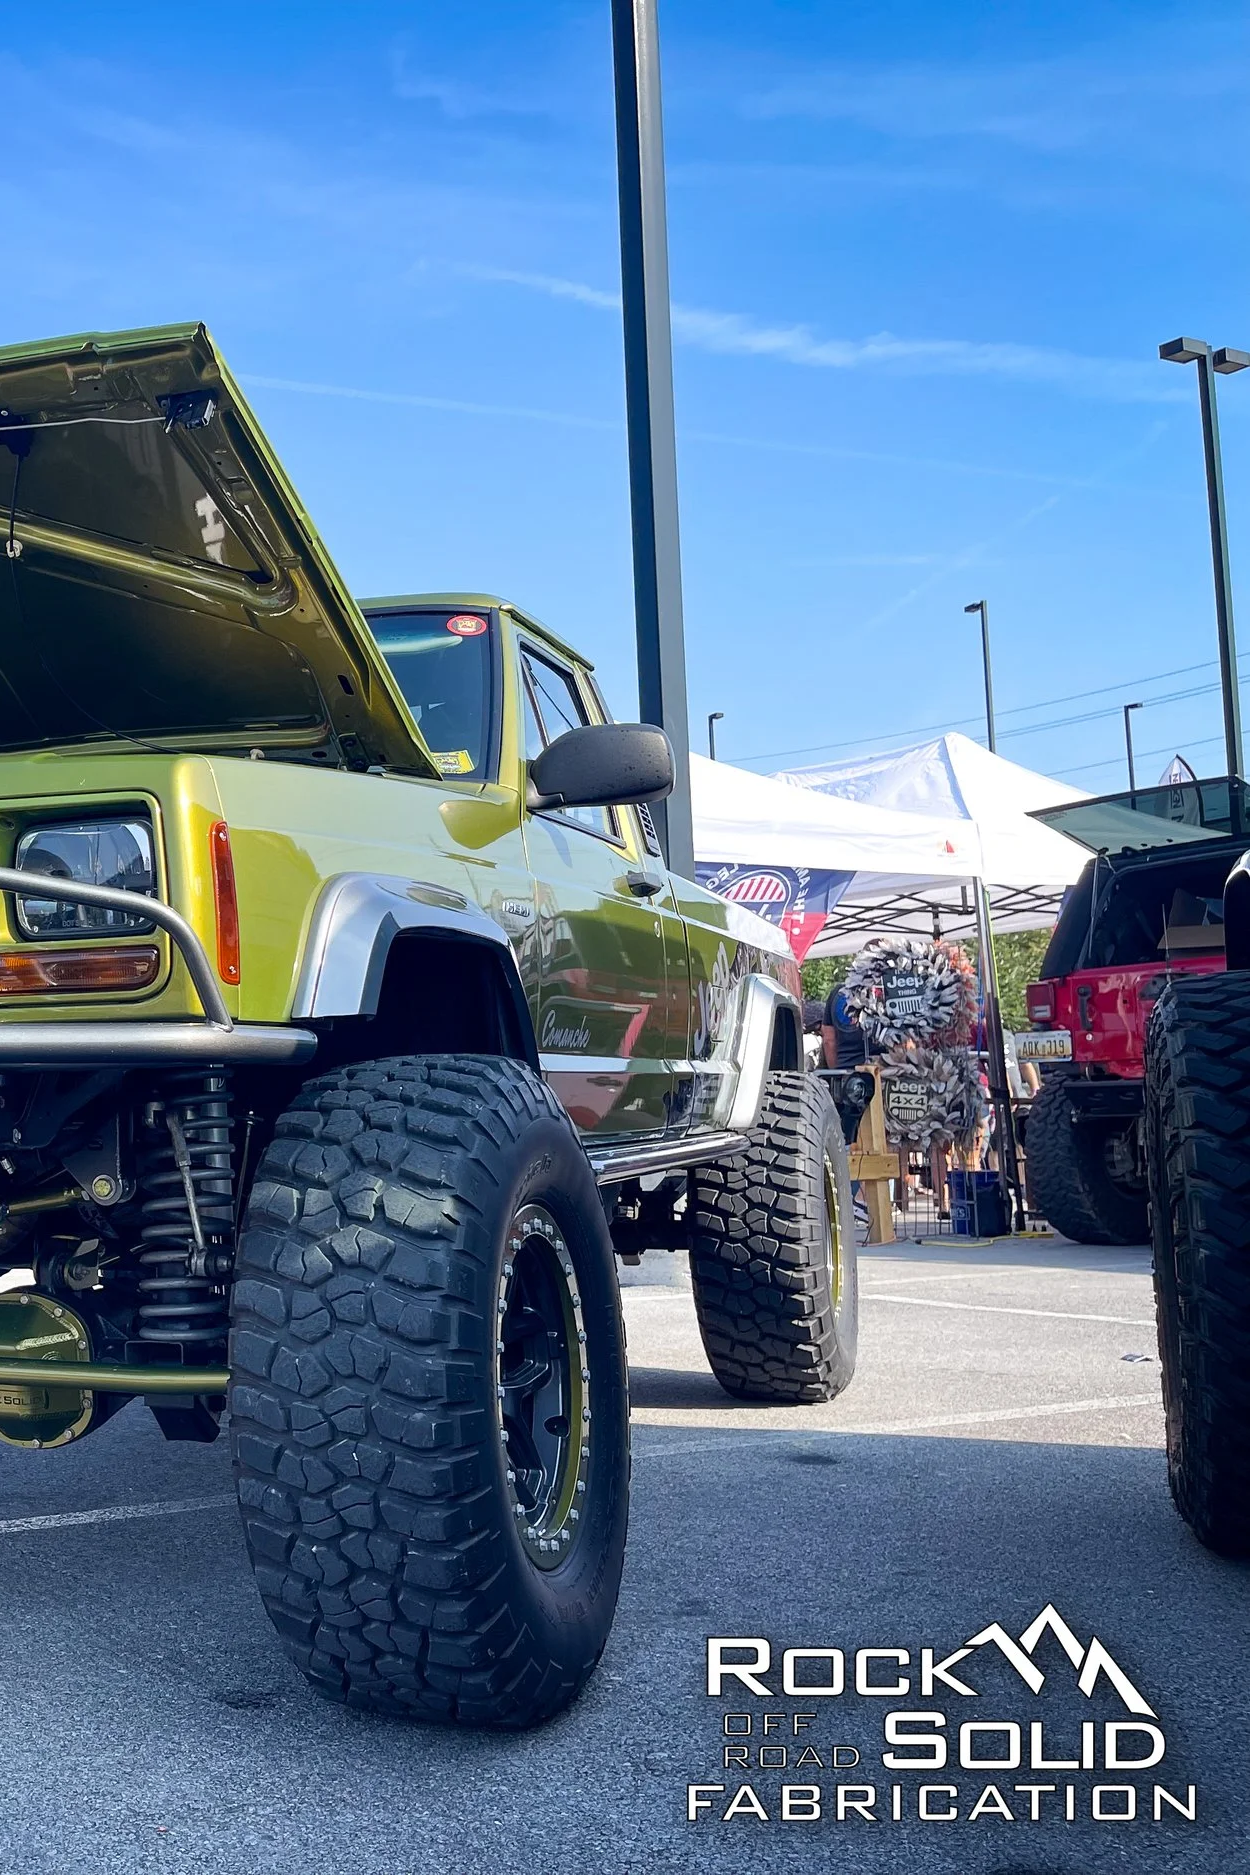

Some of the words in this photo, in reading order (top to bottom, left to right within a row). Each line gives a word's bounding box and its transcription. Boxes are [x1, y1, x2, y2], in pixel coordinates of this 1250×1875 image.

[886, 975, 924, 989] Jeep
[542, 1009, 591, 1048] Comanche
[890, 1080, 927, 1096] Jeep
